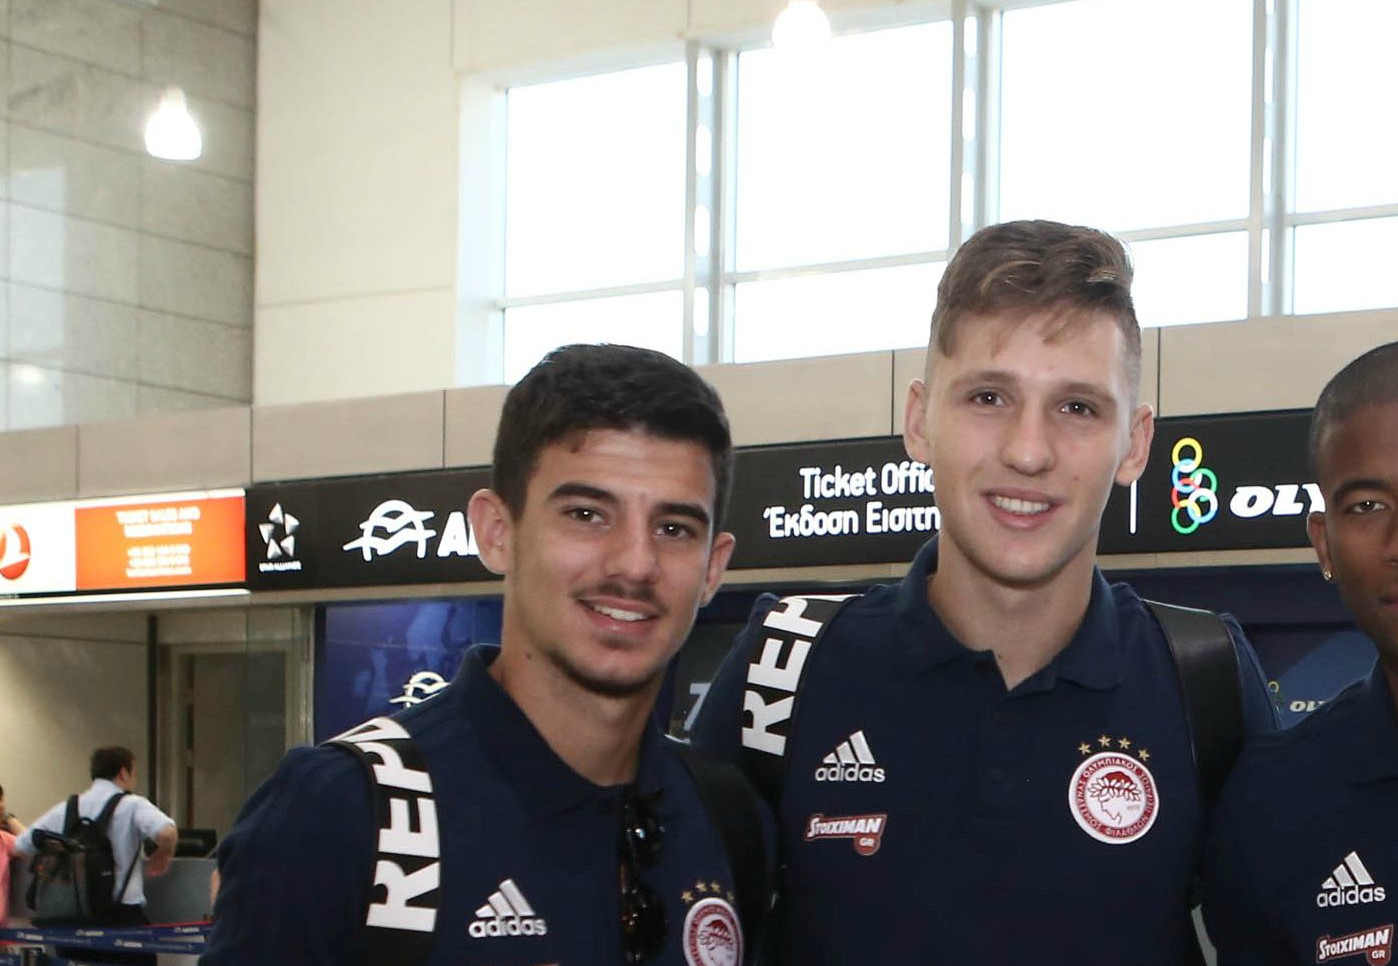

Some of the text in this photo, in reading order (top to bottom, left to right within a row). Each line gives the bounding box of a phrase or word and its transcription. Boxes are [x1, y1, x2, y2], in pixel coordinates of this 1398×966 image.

[799, 465, 878, 499] Ticket
[763, 504, 859, 538] Έκδοση
[437, 511, 480, 557] A
[815, 762, 886, 783] adidas
[1316, 884, 1386, 908] adidas
[468, 916, 548, 938] adidas
[1371, 950, 1385, 959] GR
